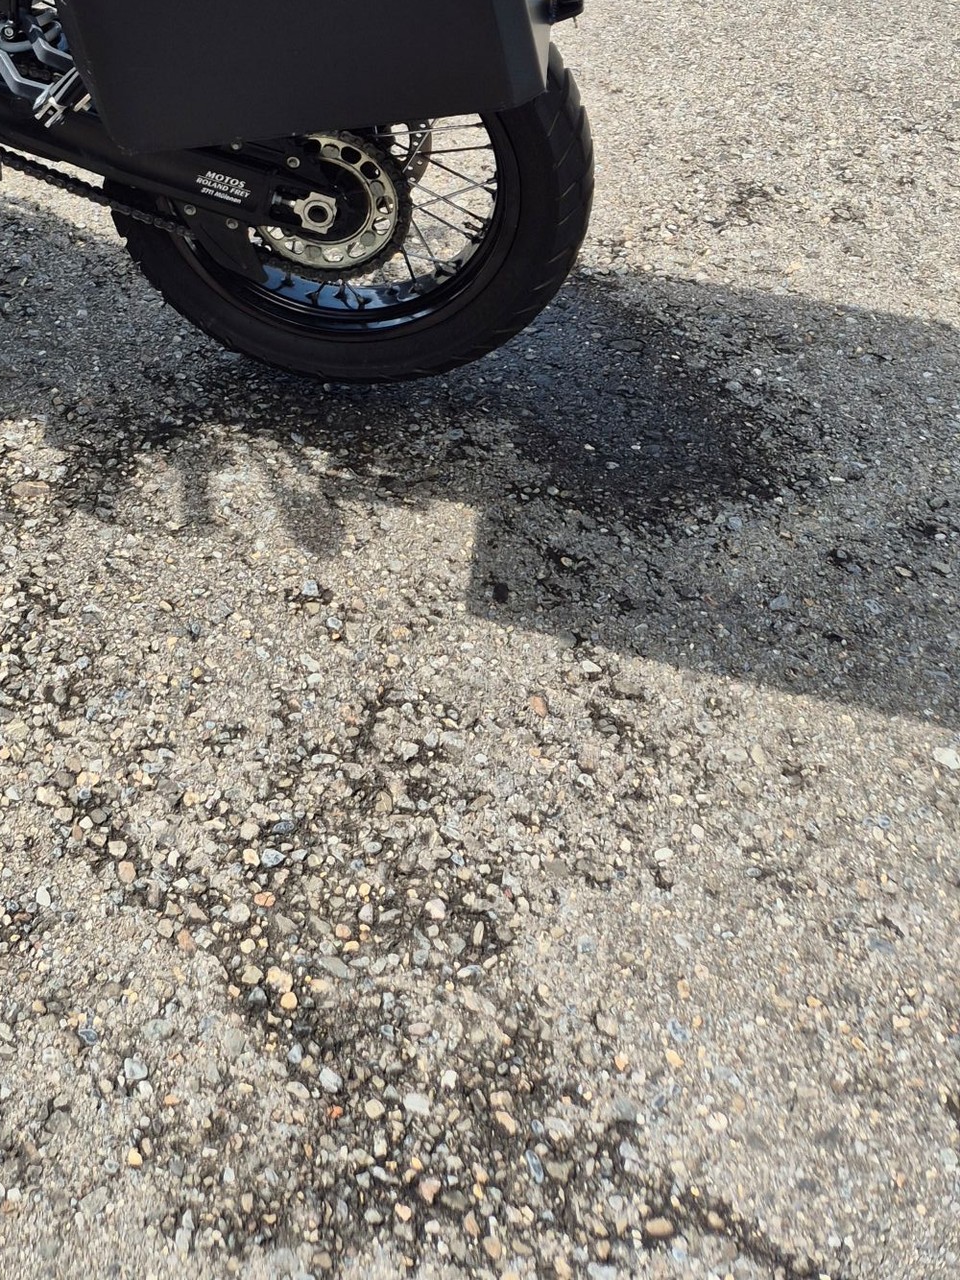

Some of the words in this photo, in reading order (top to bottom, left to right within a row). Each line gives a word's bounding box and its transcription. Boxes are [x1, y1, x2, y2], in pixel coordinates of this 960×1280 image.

[196, 177, 229, 192] ROLAND
[229, 188, 251, 198] FREY
[205, 170, 247, 188] MOTOS
